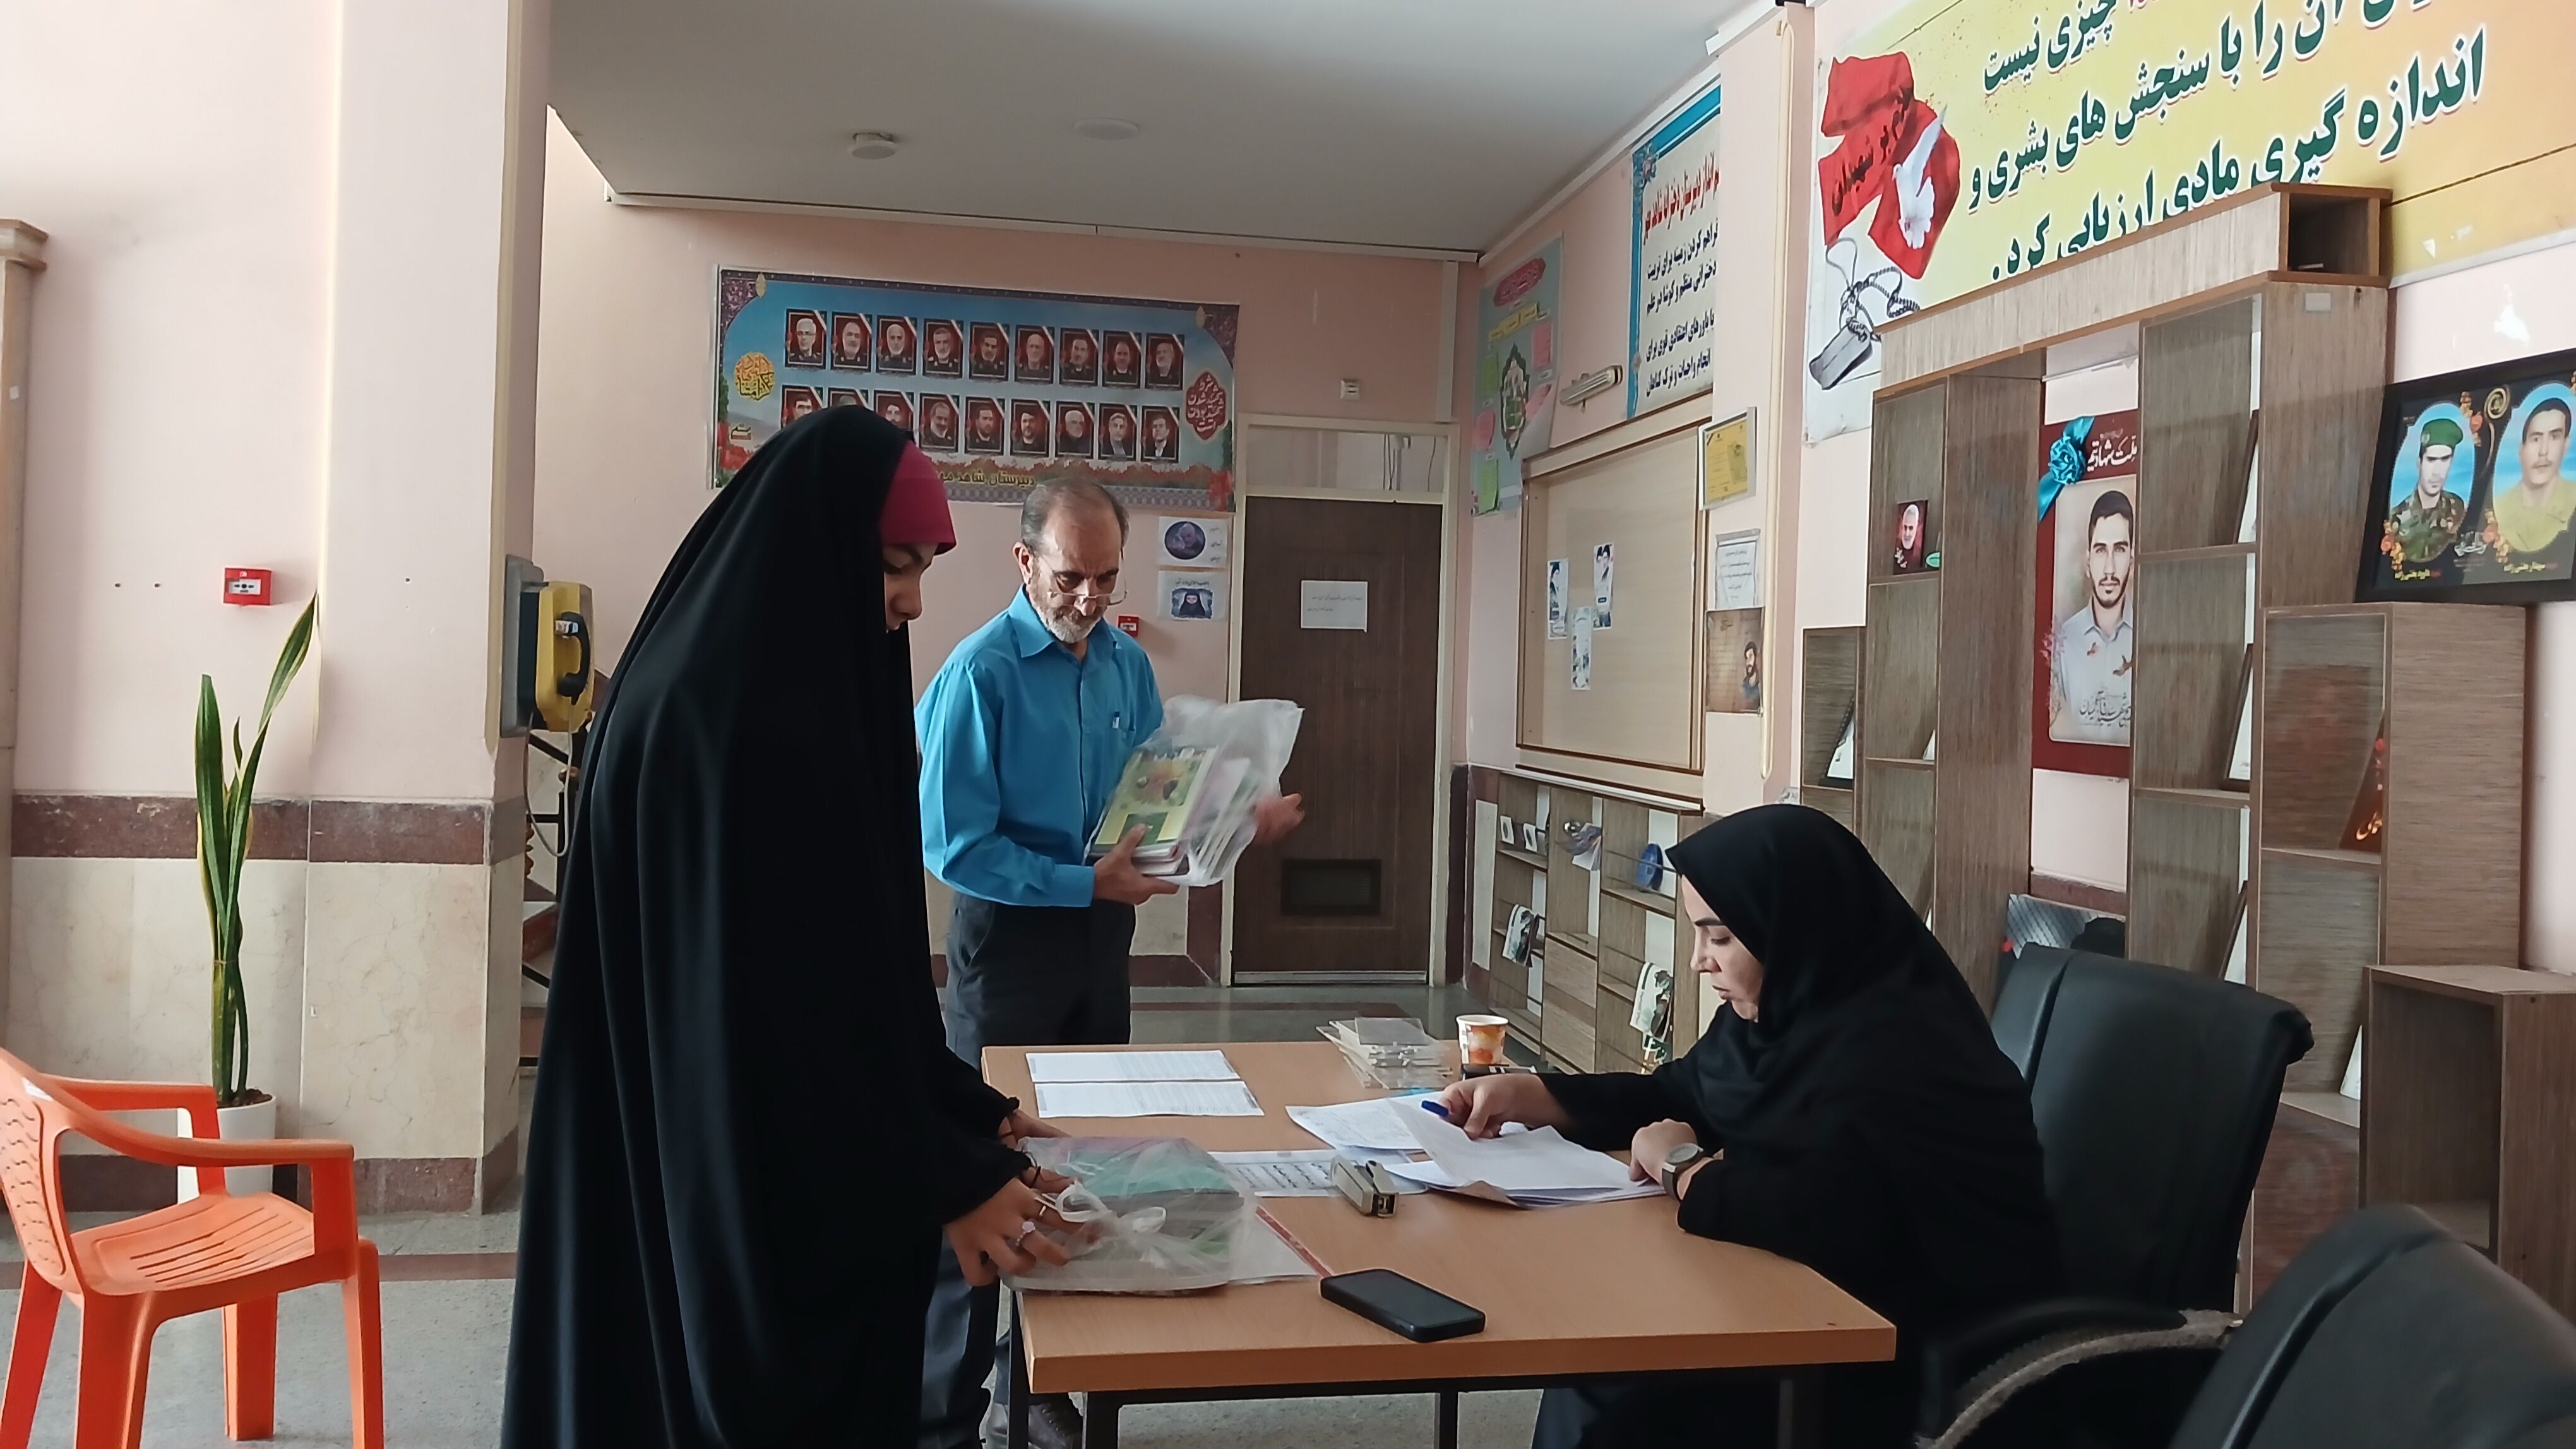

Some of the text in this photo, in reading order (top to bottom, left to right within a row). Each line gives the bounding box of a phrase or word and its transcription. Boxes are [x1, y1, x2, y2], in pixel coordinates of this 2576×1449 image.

[1984, 16, 2039, 92] نیست
[2221, 15, 2242, 84] با
[2056, 90, 2107, 167] های
[2115, 49, 2210, 140] سنجش
[2358, 28, 2484, 157] اندازه
[1968, 167, 1981, 210] و
[1988, 120, 2049, 199] بشری
[2163, 139, 2239, 220] مادی
[1688, 229, 1702, 261] کردن
[1703, 217, 1719, 252] فراهم
[958, 469, 985, 483] شاهد
[989, 471, 1034, 487] دبیرستان
